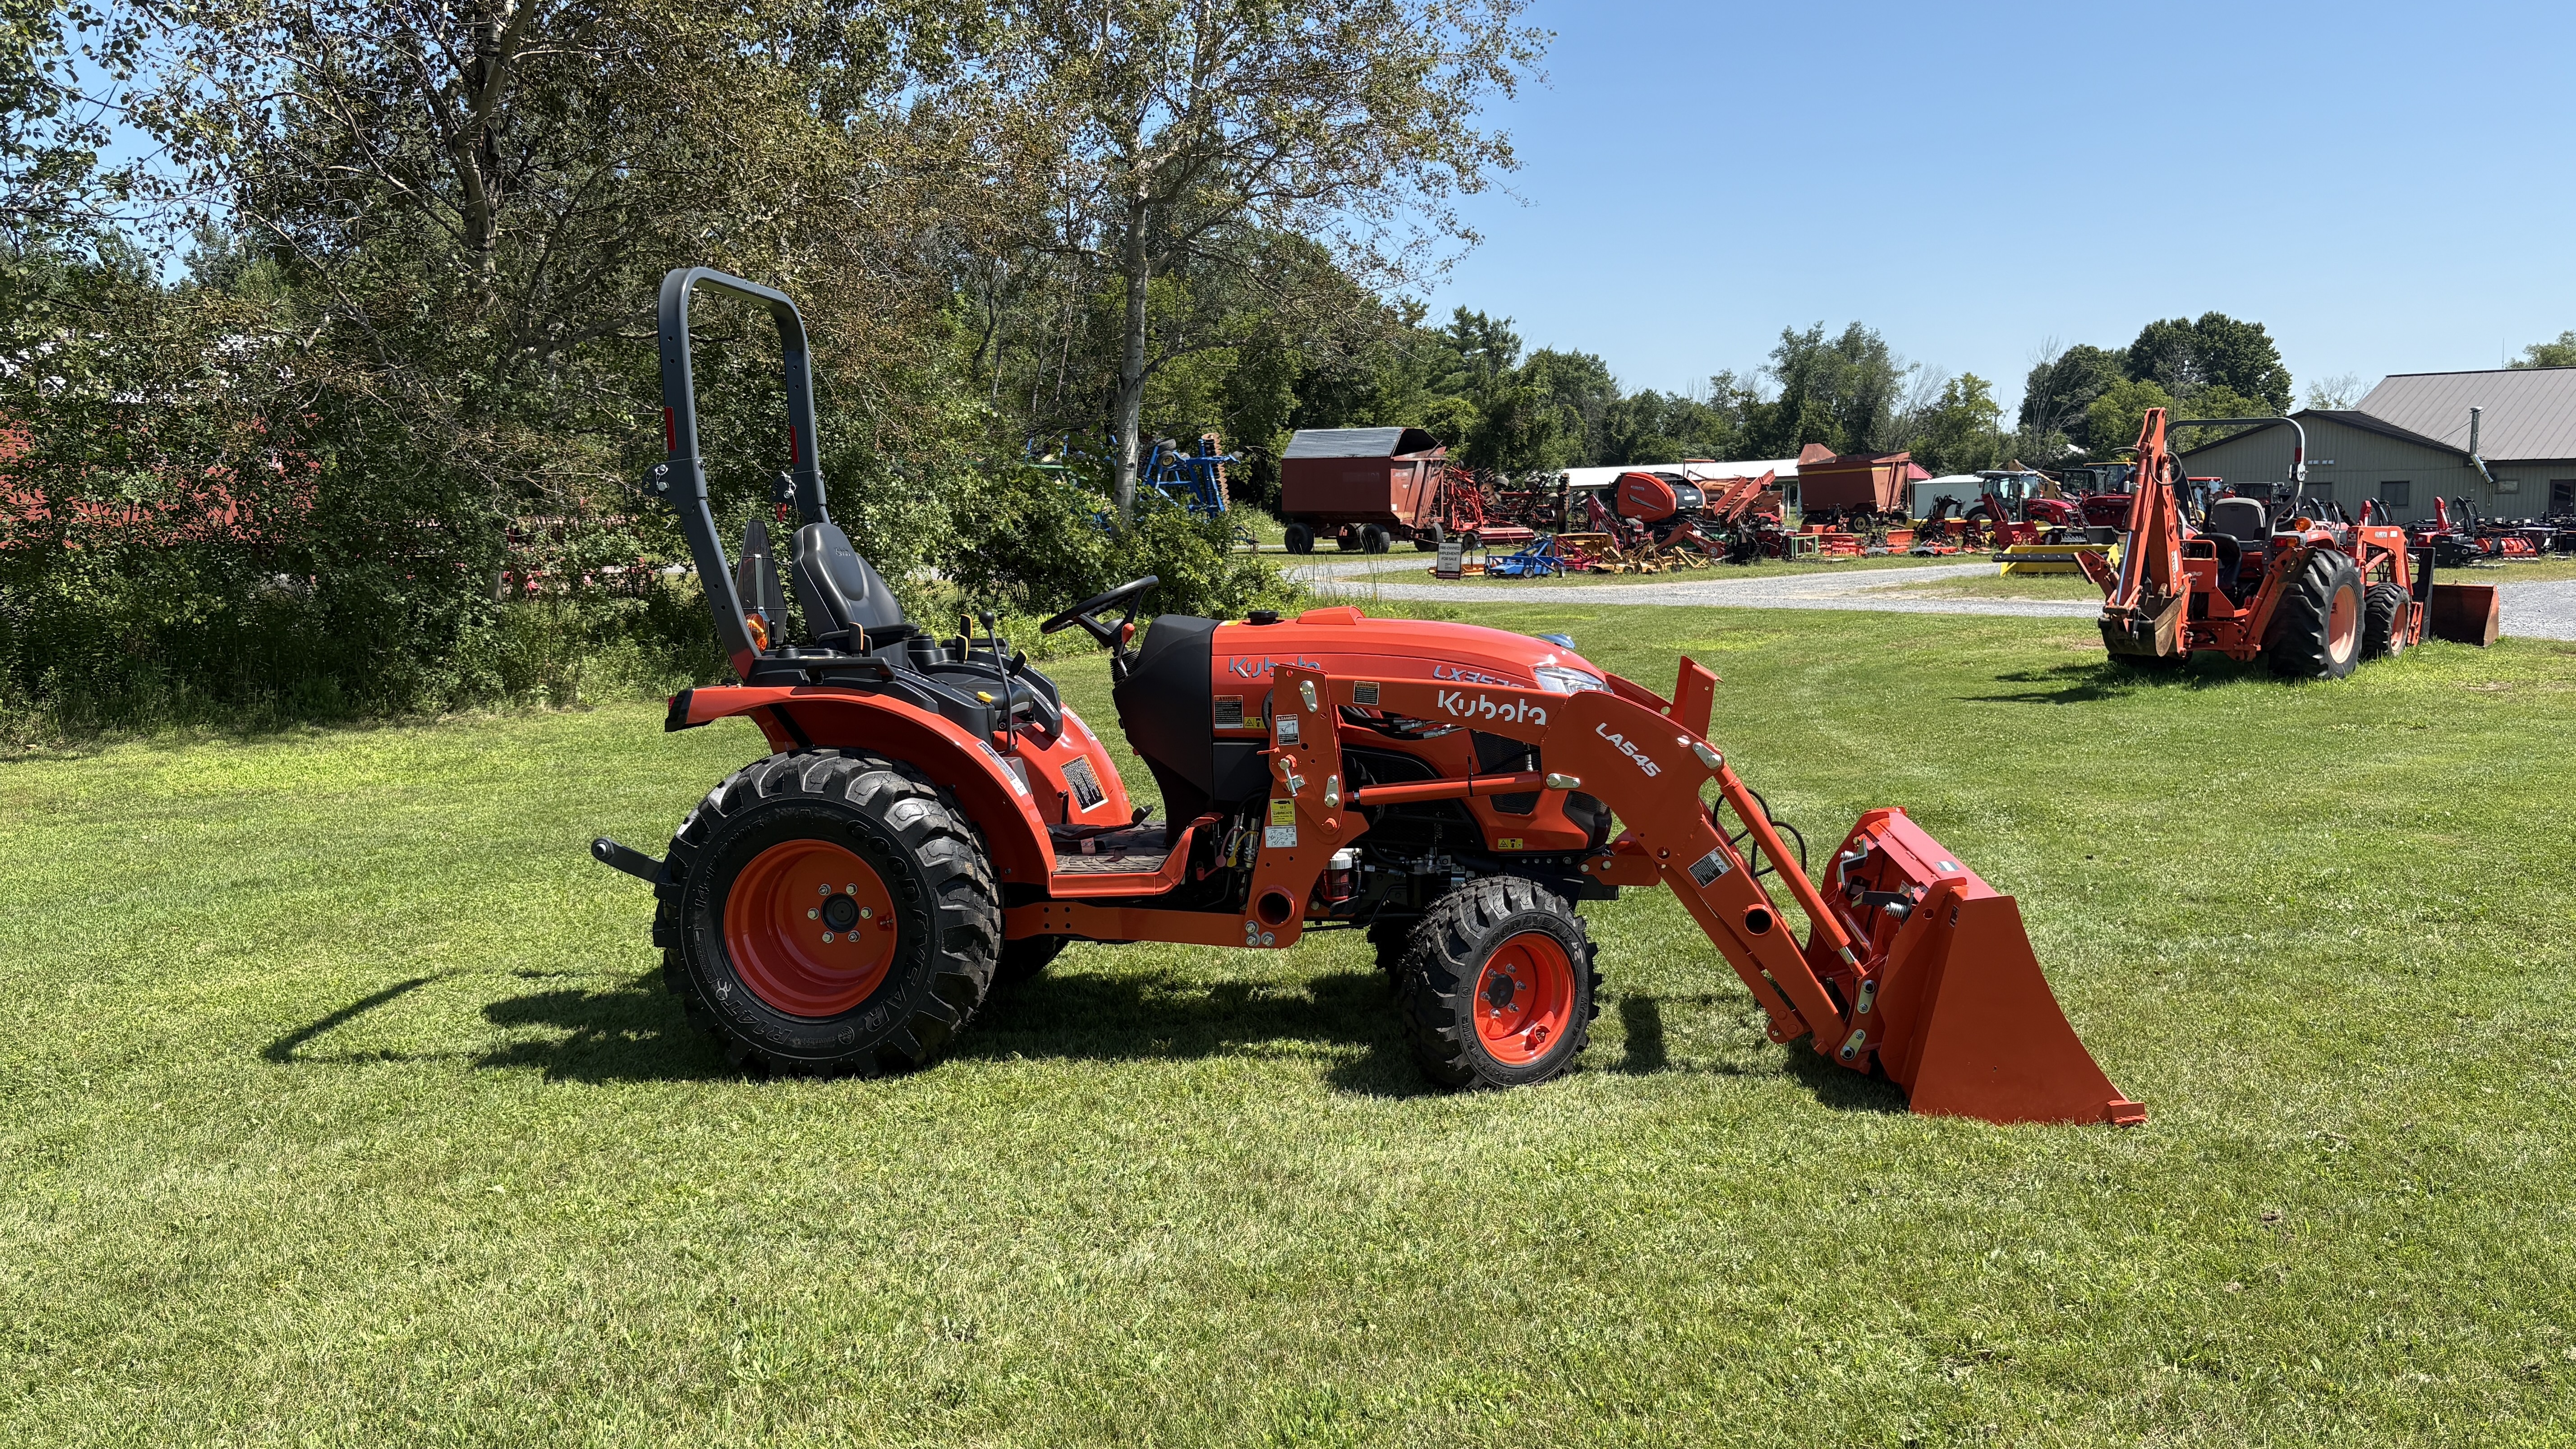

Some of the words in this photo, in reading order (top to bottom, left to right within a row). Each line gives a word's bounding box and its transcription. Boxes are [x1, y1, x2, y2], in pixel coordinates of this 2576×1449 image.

[1437, 690, 1547, 725] Kubota
[1596, 722, 1662, 777] LA545
[846, 819, 929, 1032] GOODYEAR
[1481, 915, 1573, 955] GOODYEAR
